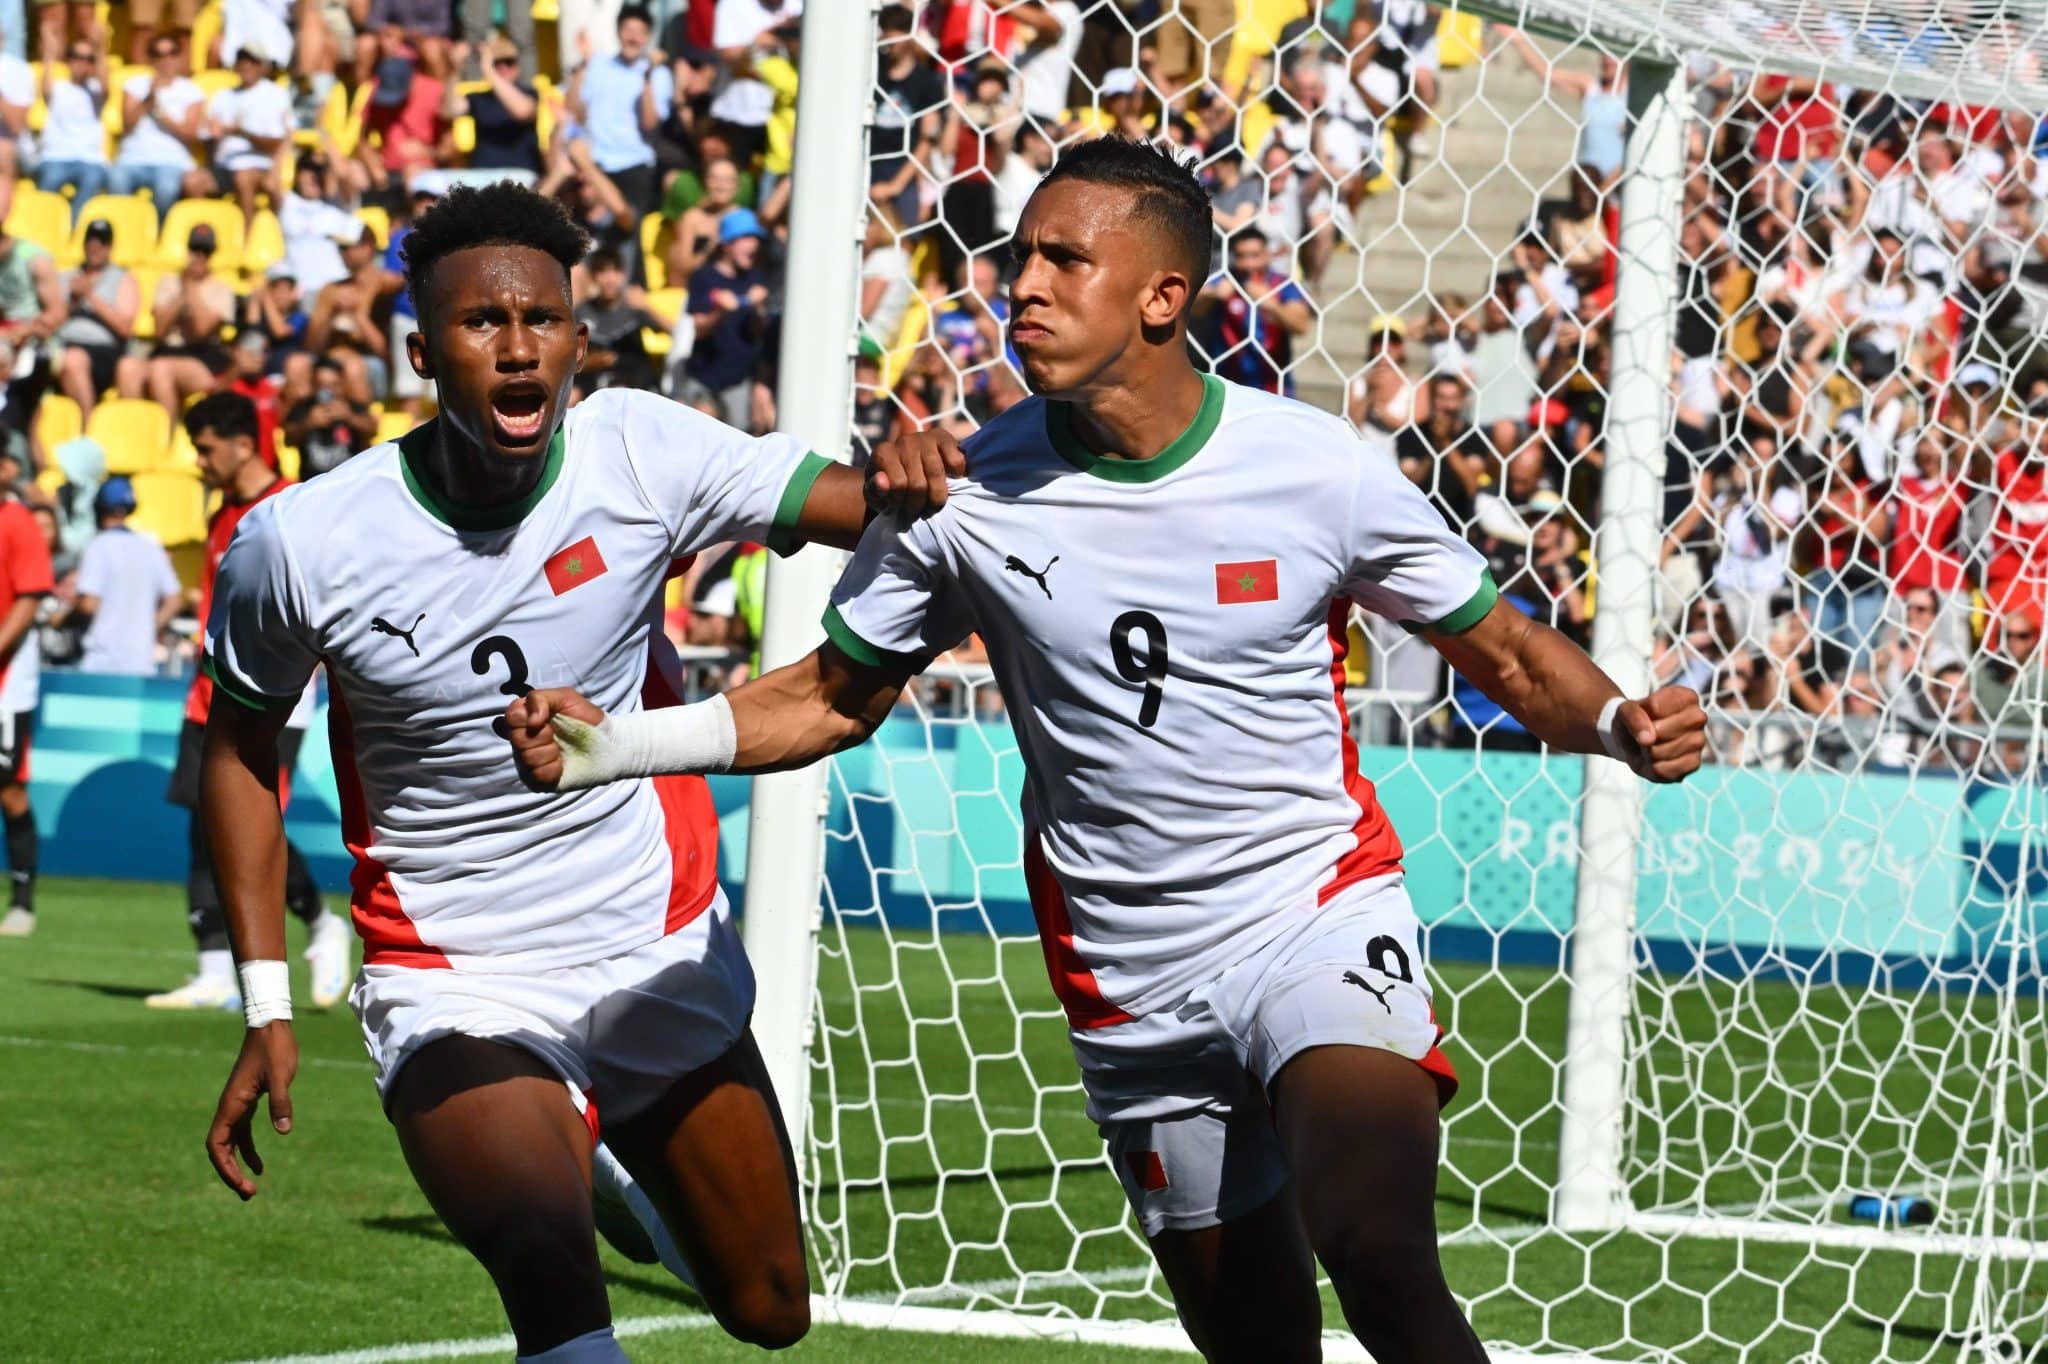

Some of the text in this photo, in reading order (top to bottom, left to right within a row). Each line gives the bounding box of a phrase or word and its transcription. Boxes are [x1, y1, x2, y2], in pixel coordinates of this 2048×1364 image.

[470, 634, 536, 741] 3
[1109, 609, 1169, 728] 9
[1499, 817, 1915, 889] PAIS 2024
